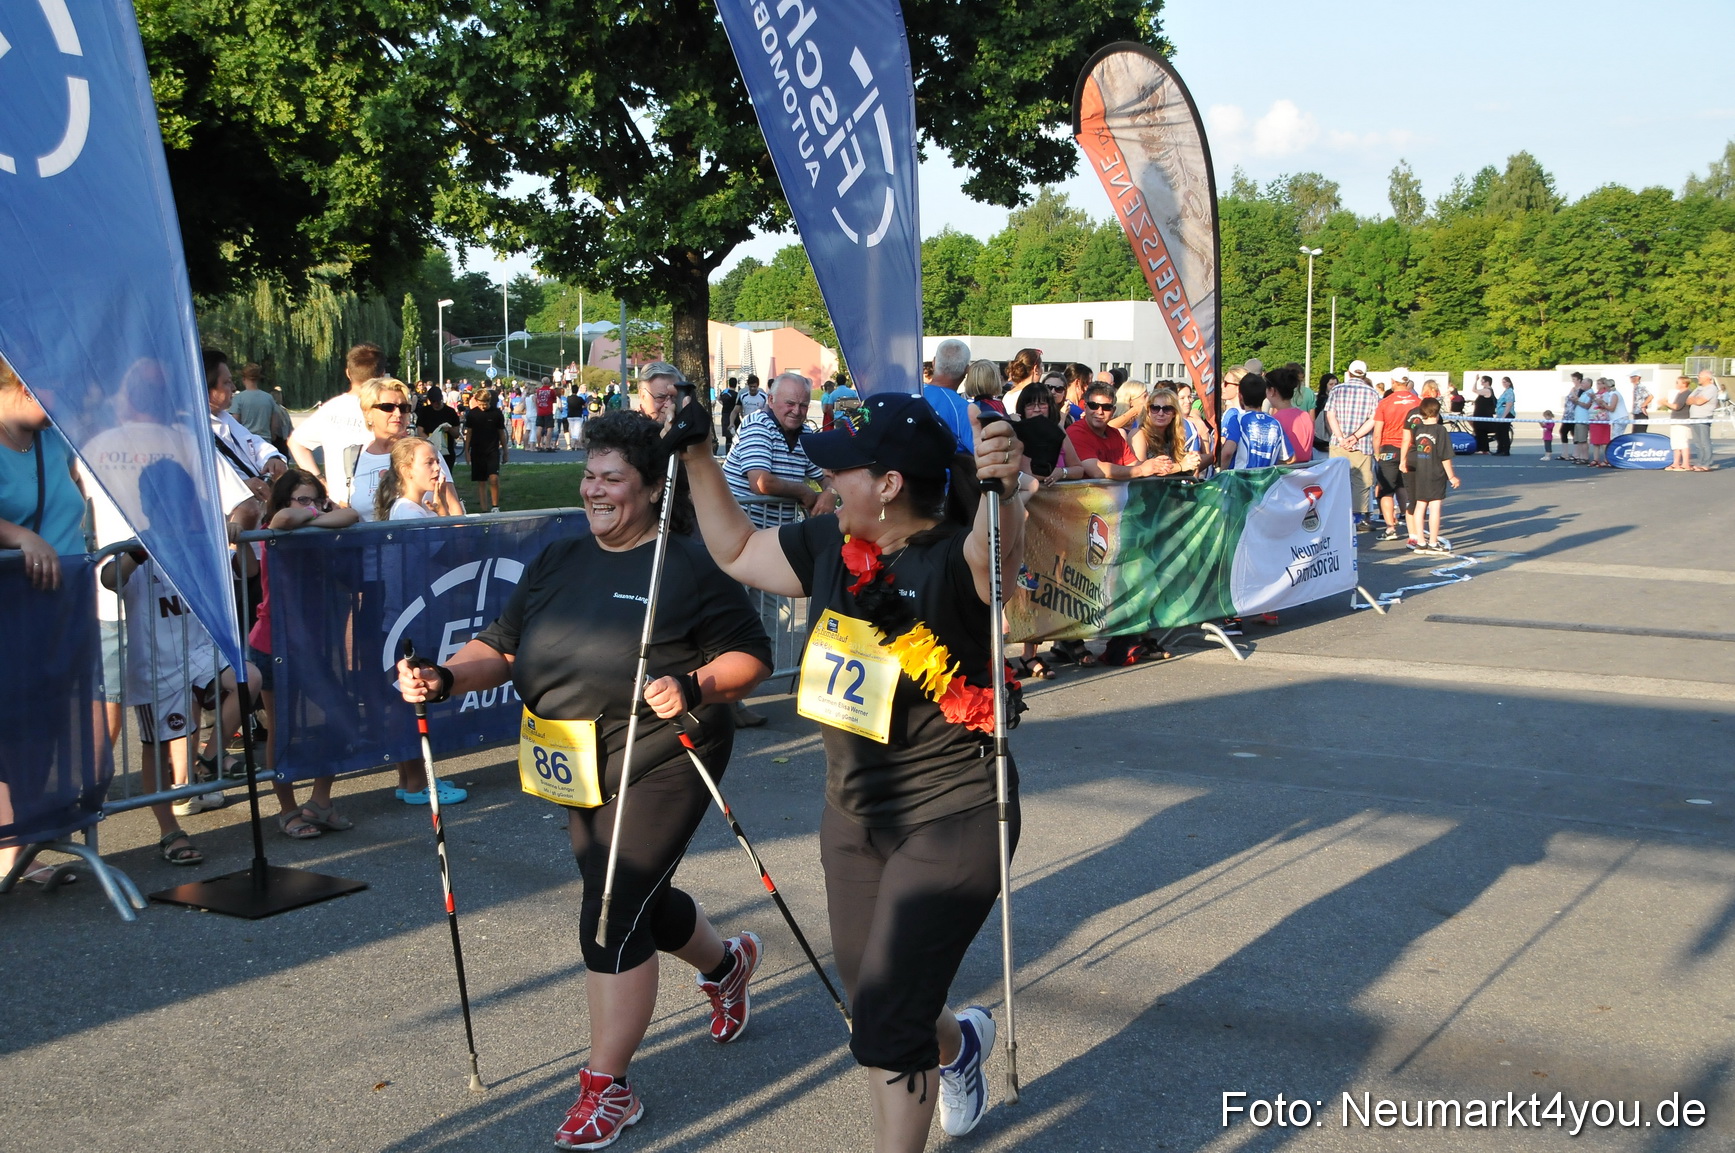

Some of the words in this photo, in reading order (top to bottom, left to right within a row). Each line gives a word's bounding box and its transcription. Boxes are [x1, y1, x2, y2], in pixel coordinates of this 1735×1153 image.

[1624, 448, 1669, 457] Fischer
[825, 652, 866, 705] 72
[850, 705, 869, 717] Werner
[533, 746, 572, 784] 86
